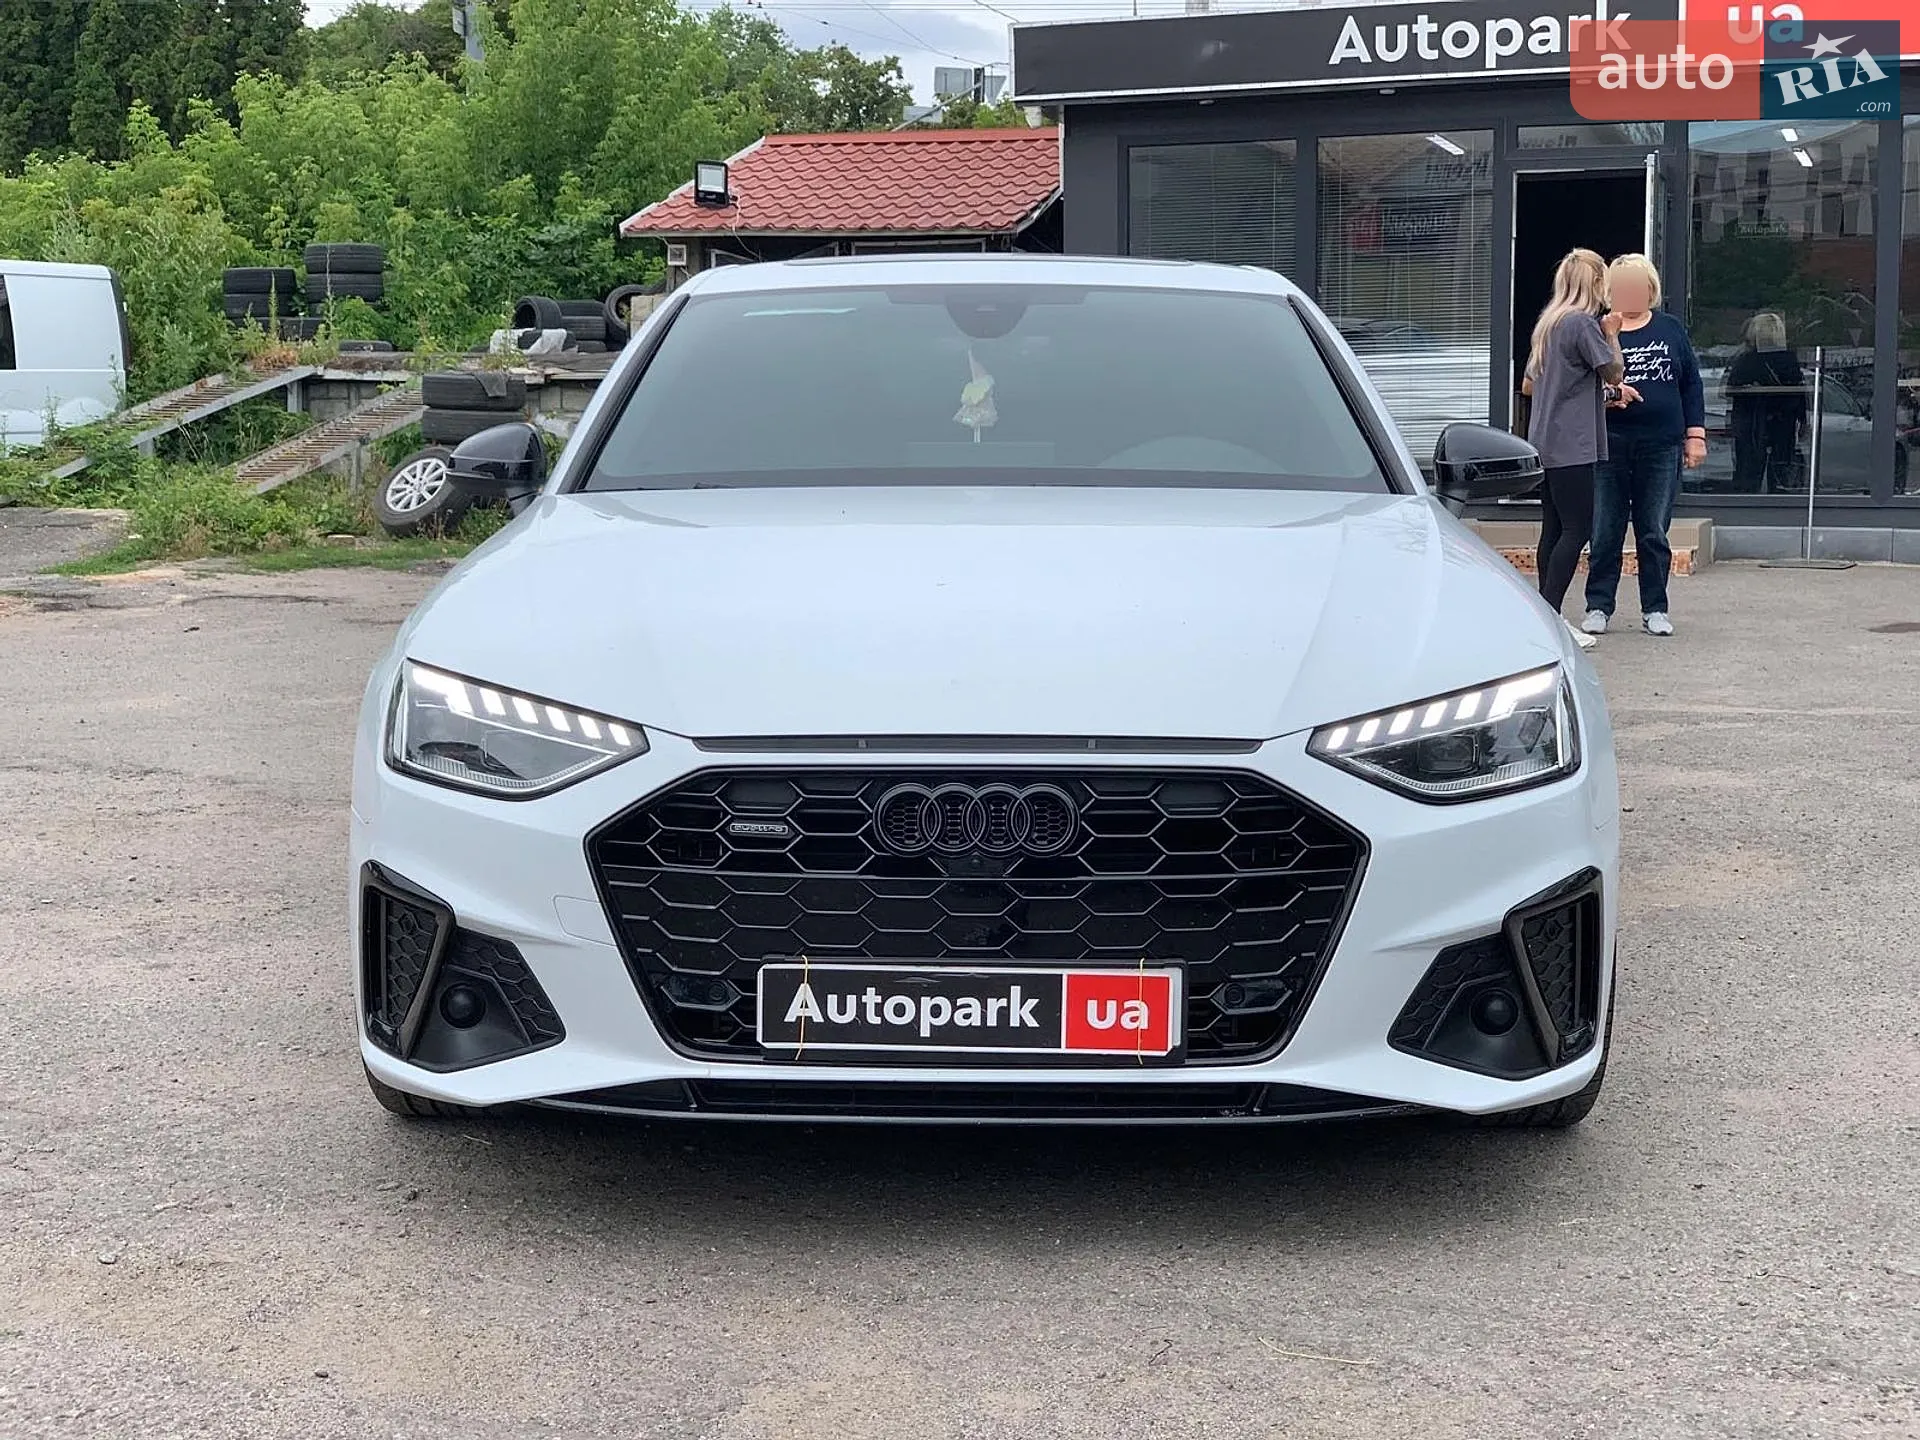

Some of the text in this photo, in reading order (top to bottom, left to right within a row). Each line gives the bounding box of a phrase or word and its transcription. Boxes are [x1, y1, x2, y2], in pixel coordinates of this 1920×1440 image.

[1328, 0, 1804, 69] Autopark ua
[783, 983, 1150, 1037] Autopark ua
